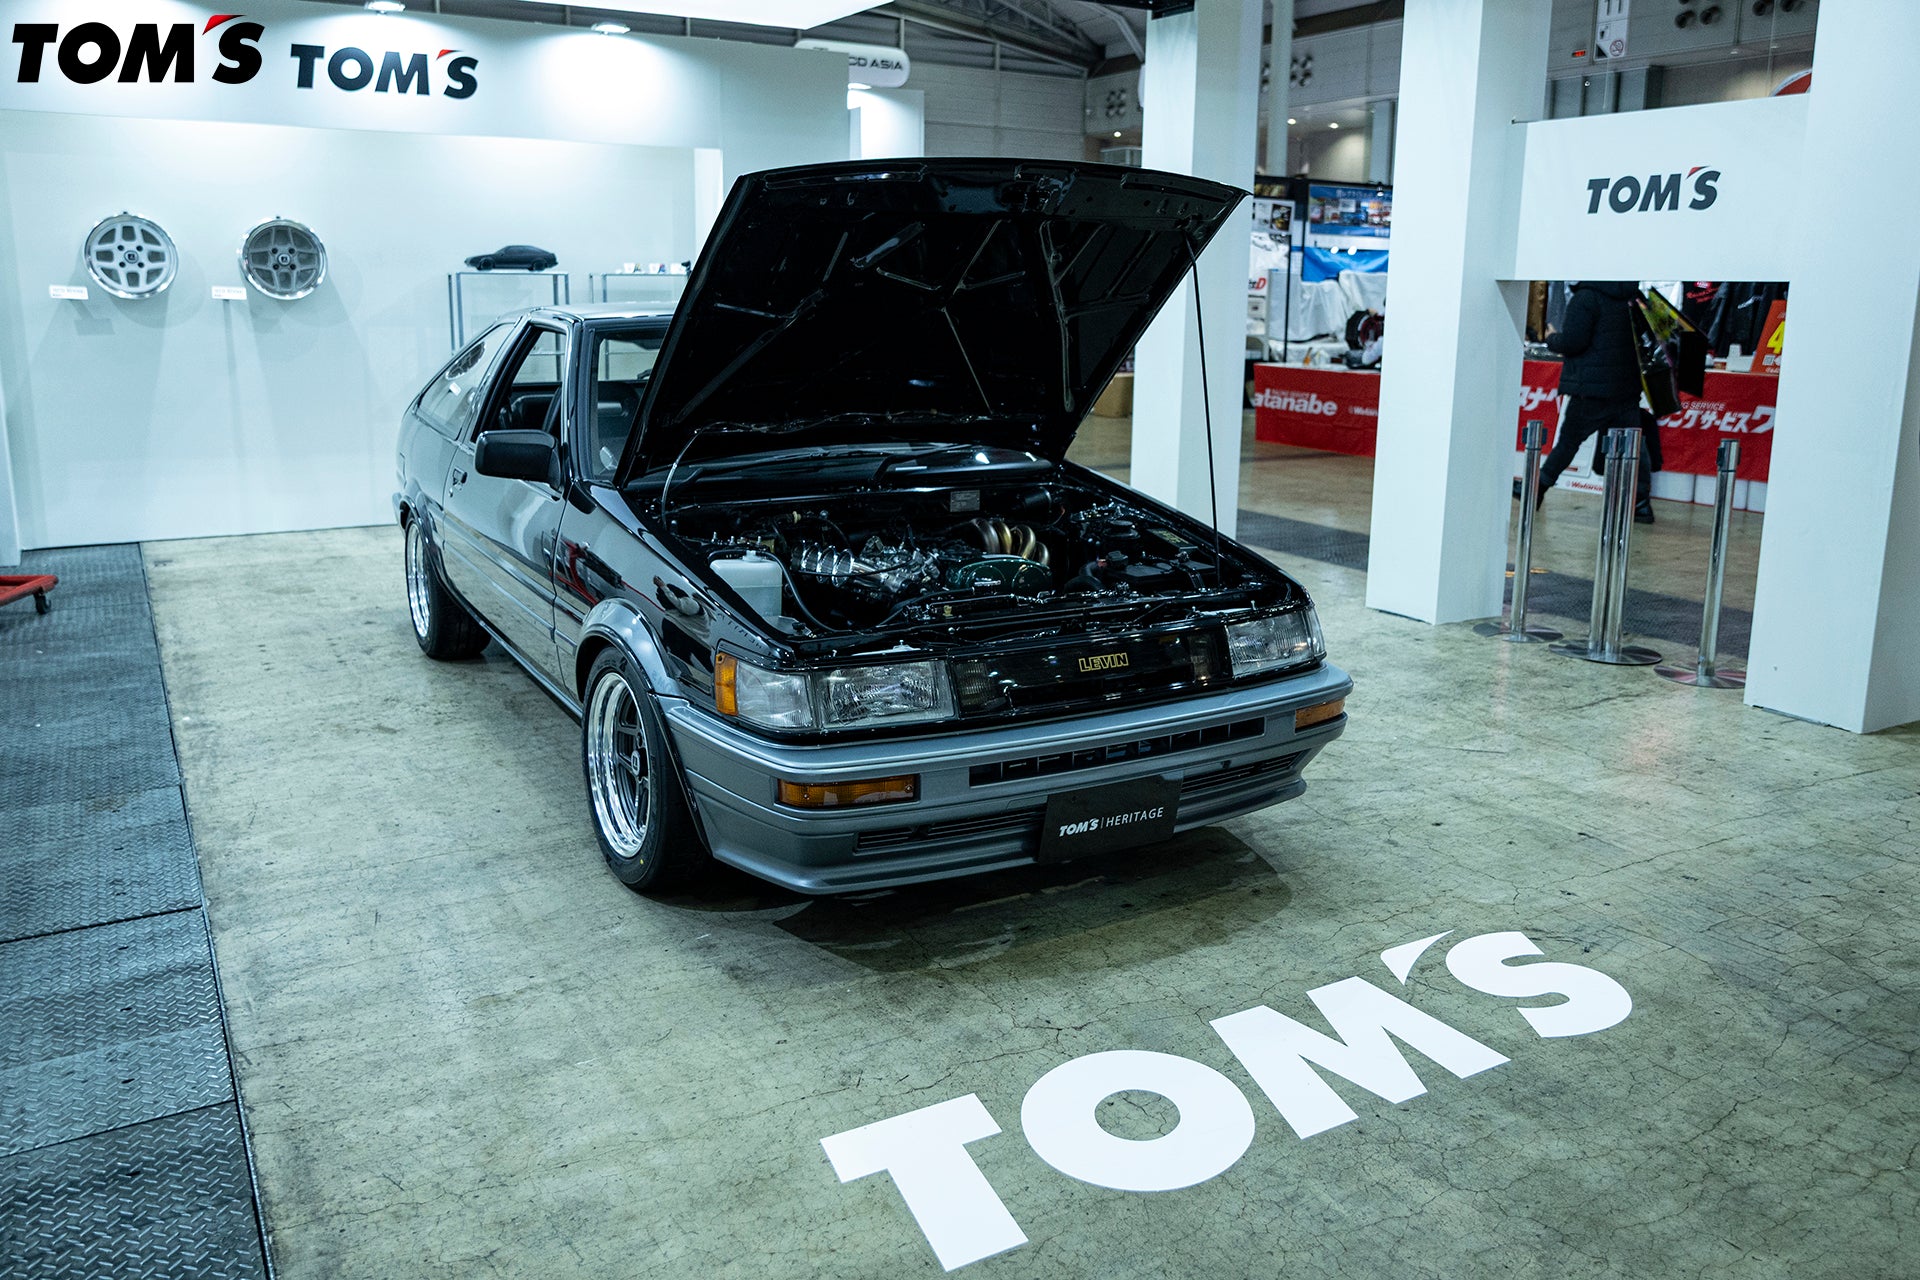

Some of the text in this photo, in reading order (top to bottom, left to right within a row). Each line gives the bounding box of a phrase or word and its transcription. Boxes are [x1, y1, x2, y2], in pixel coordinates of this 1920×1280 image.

[290, 43, 479, 100] TOM'S
[870, 58, 903, 70] ASIA
[1586, 165, 1722, 214] TOM'S
[1689, 401, 1726, 412] SERVICE
[1078, 652, 1129, 672] LEVIN
[1059, 807, 1164, 837] TOM'S HERITAGE
[820, 929, 1634, 1273] TOM'S
